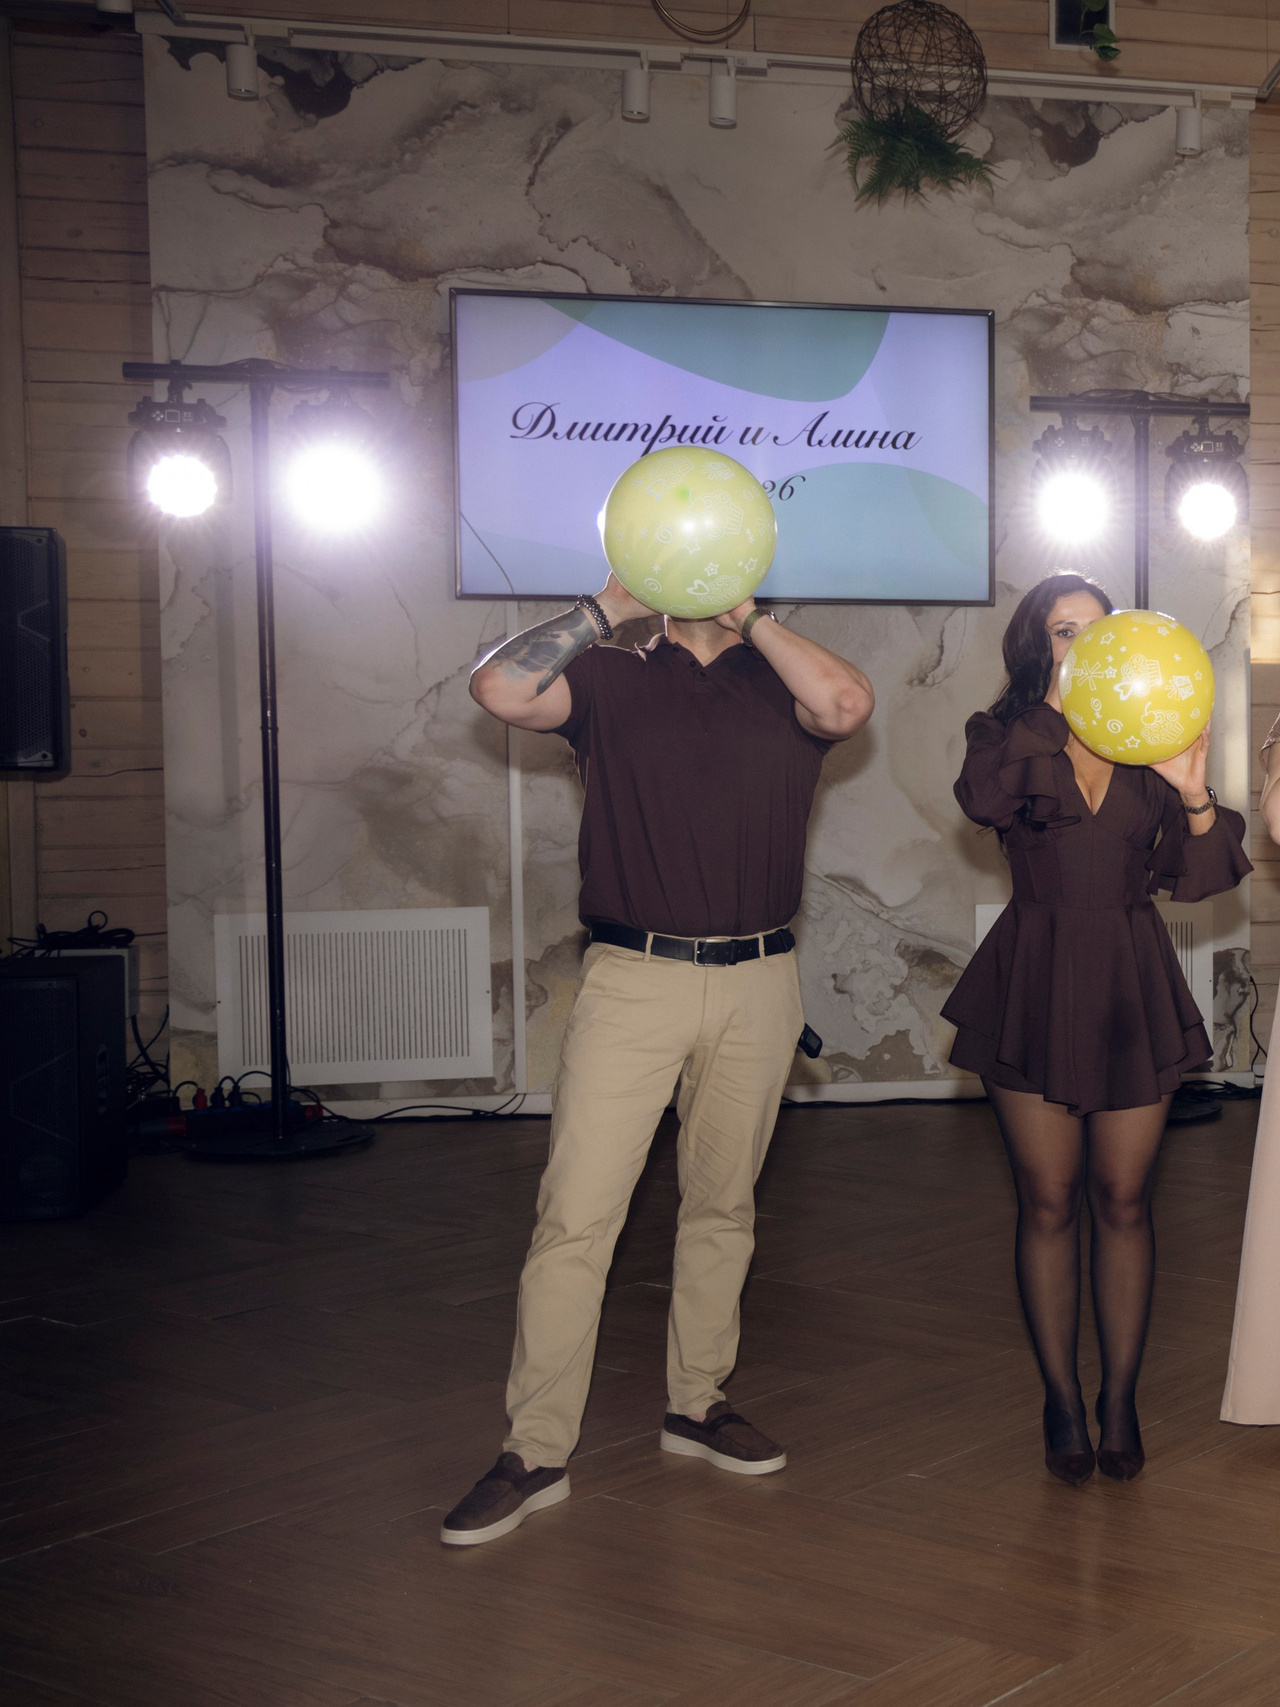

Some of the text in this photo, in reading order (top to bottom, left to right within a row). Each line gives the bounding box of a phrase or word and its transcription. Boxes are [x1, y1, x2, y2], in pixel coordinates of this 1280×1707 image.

[510, 401, 921, 456] Дмитрий и Алина
